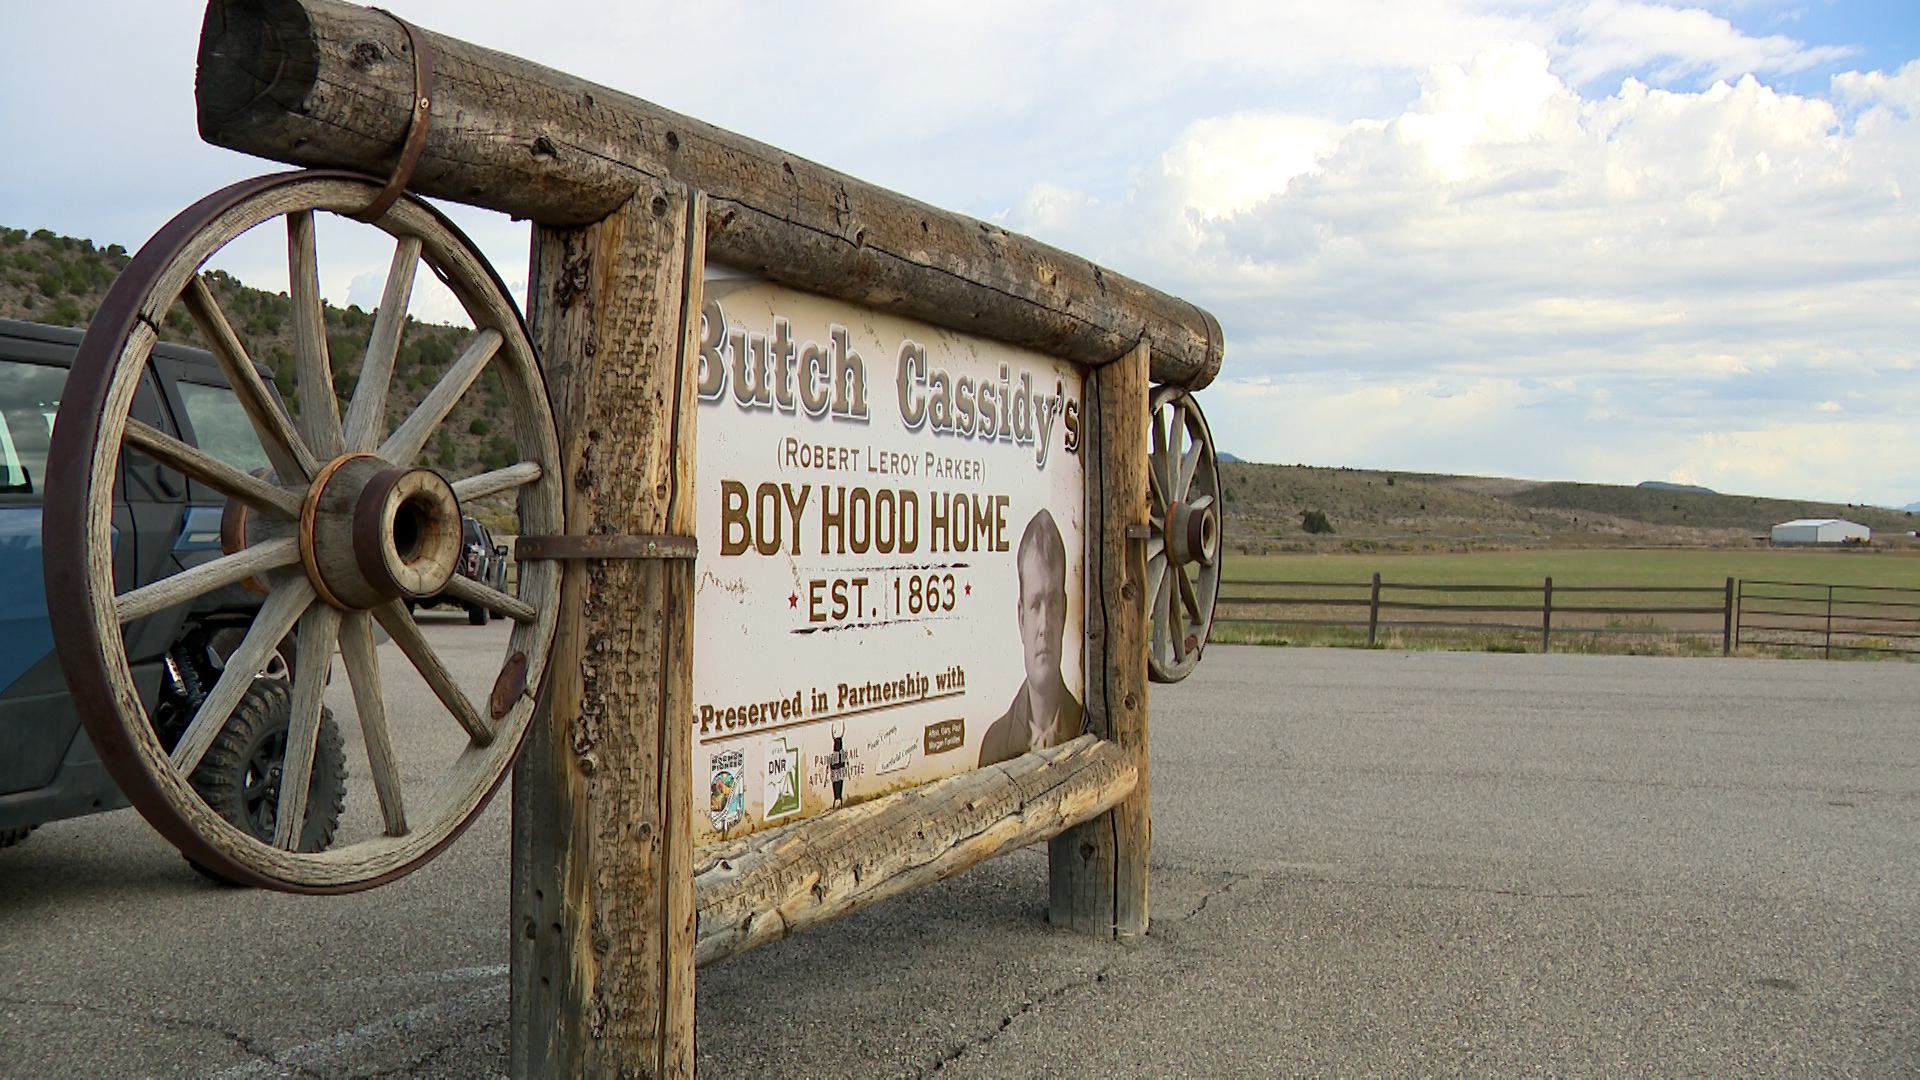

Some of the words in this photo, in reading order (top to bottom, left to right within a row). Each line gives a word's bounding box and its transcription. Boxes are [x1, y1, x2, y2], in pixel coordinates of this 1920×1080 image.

[896, 338, 1081, 469] Cassidy's
[777, 436, 860, 472] (ROBERT
[867, 445, 919, 476] LEROY
[925, 451, 986, 486] PARKER)
[720, 479, 811, 556] BOY
[820, 485, 919, 555] HOOD
[930, 491, 1010, 552] HOME
[808, 577, 878, 622] EST.
[894, 573, 956, 616] 1863
[700, 690, 802, 734] Preserved
[811, 687, 829, 714] in
[837, 671, 930, 709] Partnership
[936, 665, 966, 690] with
[768, 758, 787, 775] DNR
